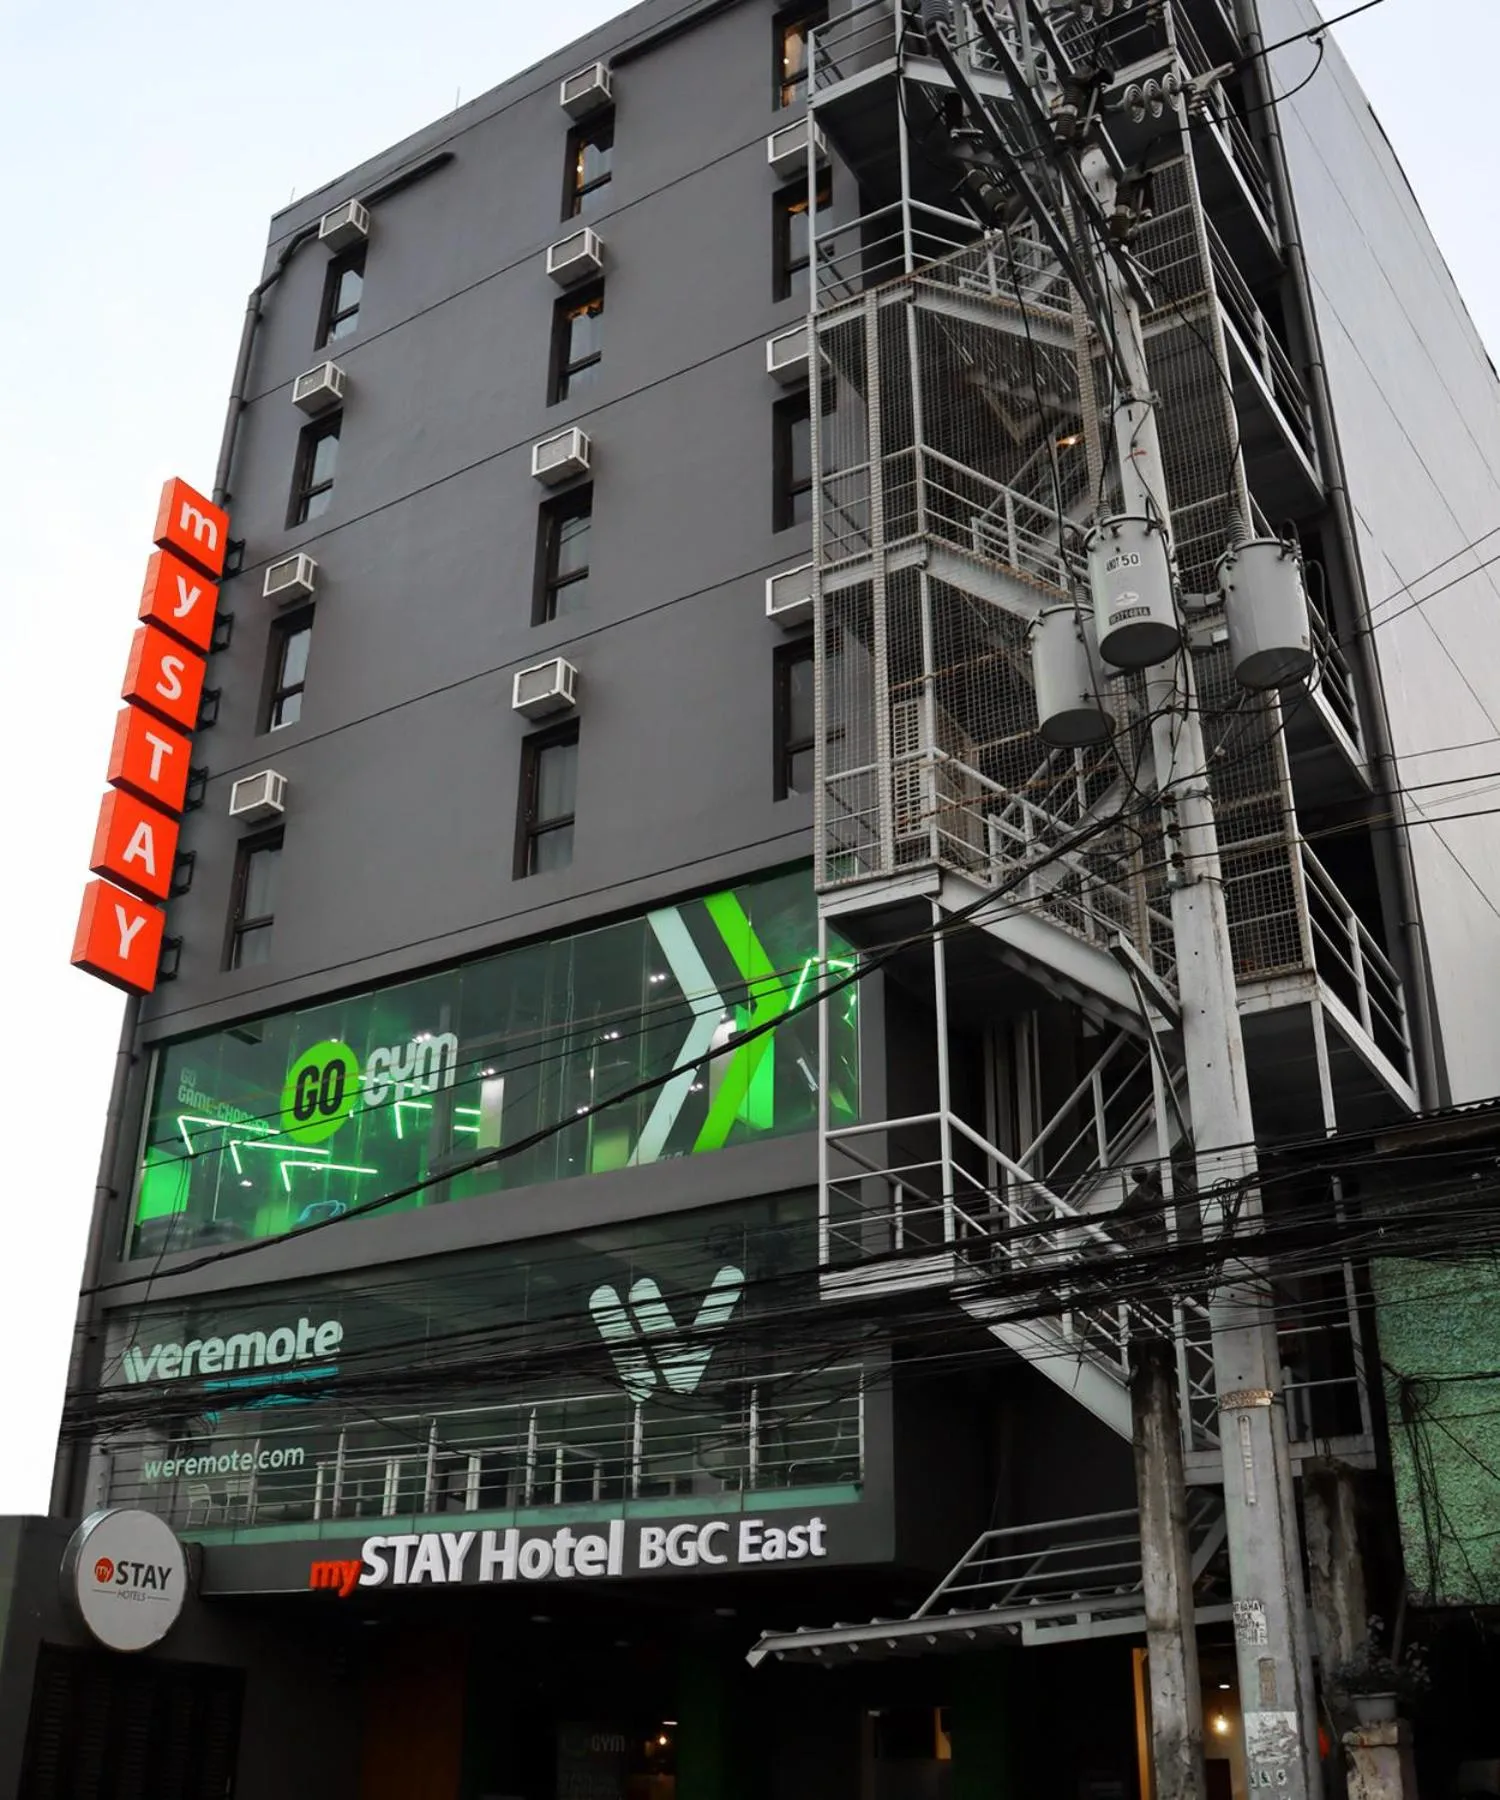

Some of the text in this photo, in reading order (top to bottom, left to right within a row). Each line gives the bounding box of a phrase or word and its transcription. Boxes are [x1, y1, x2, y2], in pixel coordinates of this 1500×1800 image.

[1121, 553, 1139, 566] 50
[294, 1058, 346, 1121] GO
[121, 1317, 344, 1384] weremote
[144, 1446, 304, 1479] weremote.com
[479, 1519, 625, 1582] Hotel
[639, 1521, 730, 1570] BGC
[738, 1516, 828, 1565] East
[115, 1560, 172, 1591] STAY
